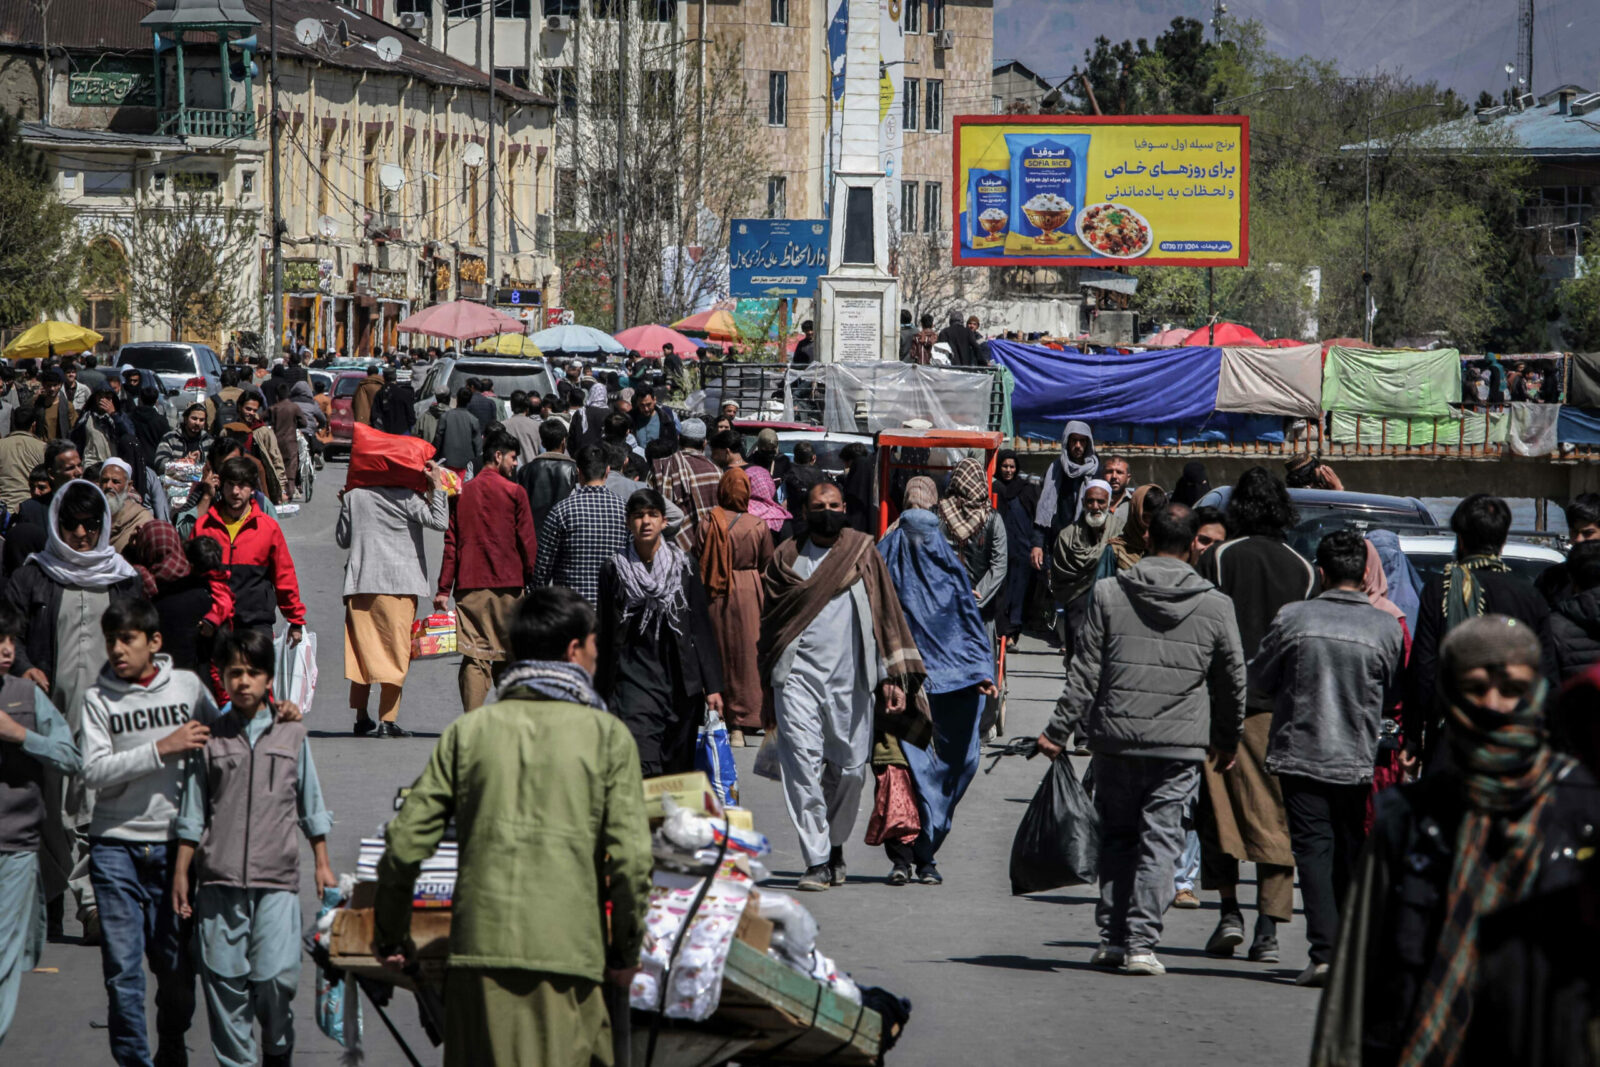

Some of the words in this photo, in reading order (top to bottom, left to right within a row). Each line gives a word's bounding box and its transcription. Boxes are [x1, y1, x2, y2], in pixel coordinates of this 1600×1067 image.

[1032, 147, 1065, 157] سوفیا
[1134, 138, 1169, 152] سوفیا
[1171, 138, 1187, 152] اول
[1190, 139, 1214, 152] سیله
[1216, 140, 1235, 152] برنج
[1104, 160, 1147, 178] خاص
[1150, 160, 1206, 178] روزهای
[1208, 160, 1236, 178] برای
[1168, 187, 1179, 200] به
[1182, 184, 1226, 198] لحظات
[1228, 189, 1234, 199] و
[730, 249, 750, 269] کابل
[110, 703, 190, 734] DICKIES
